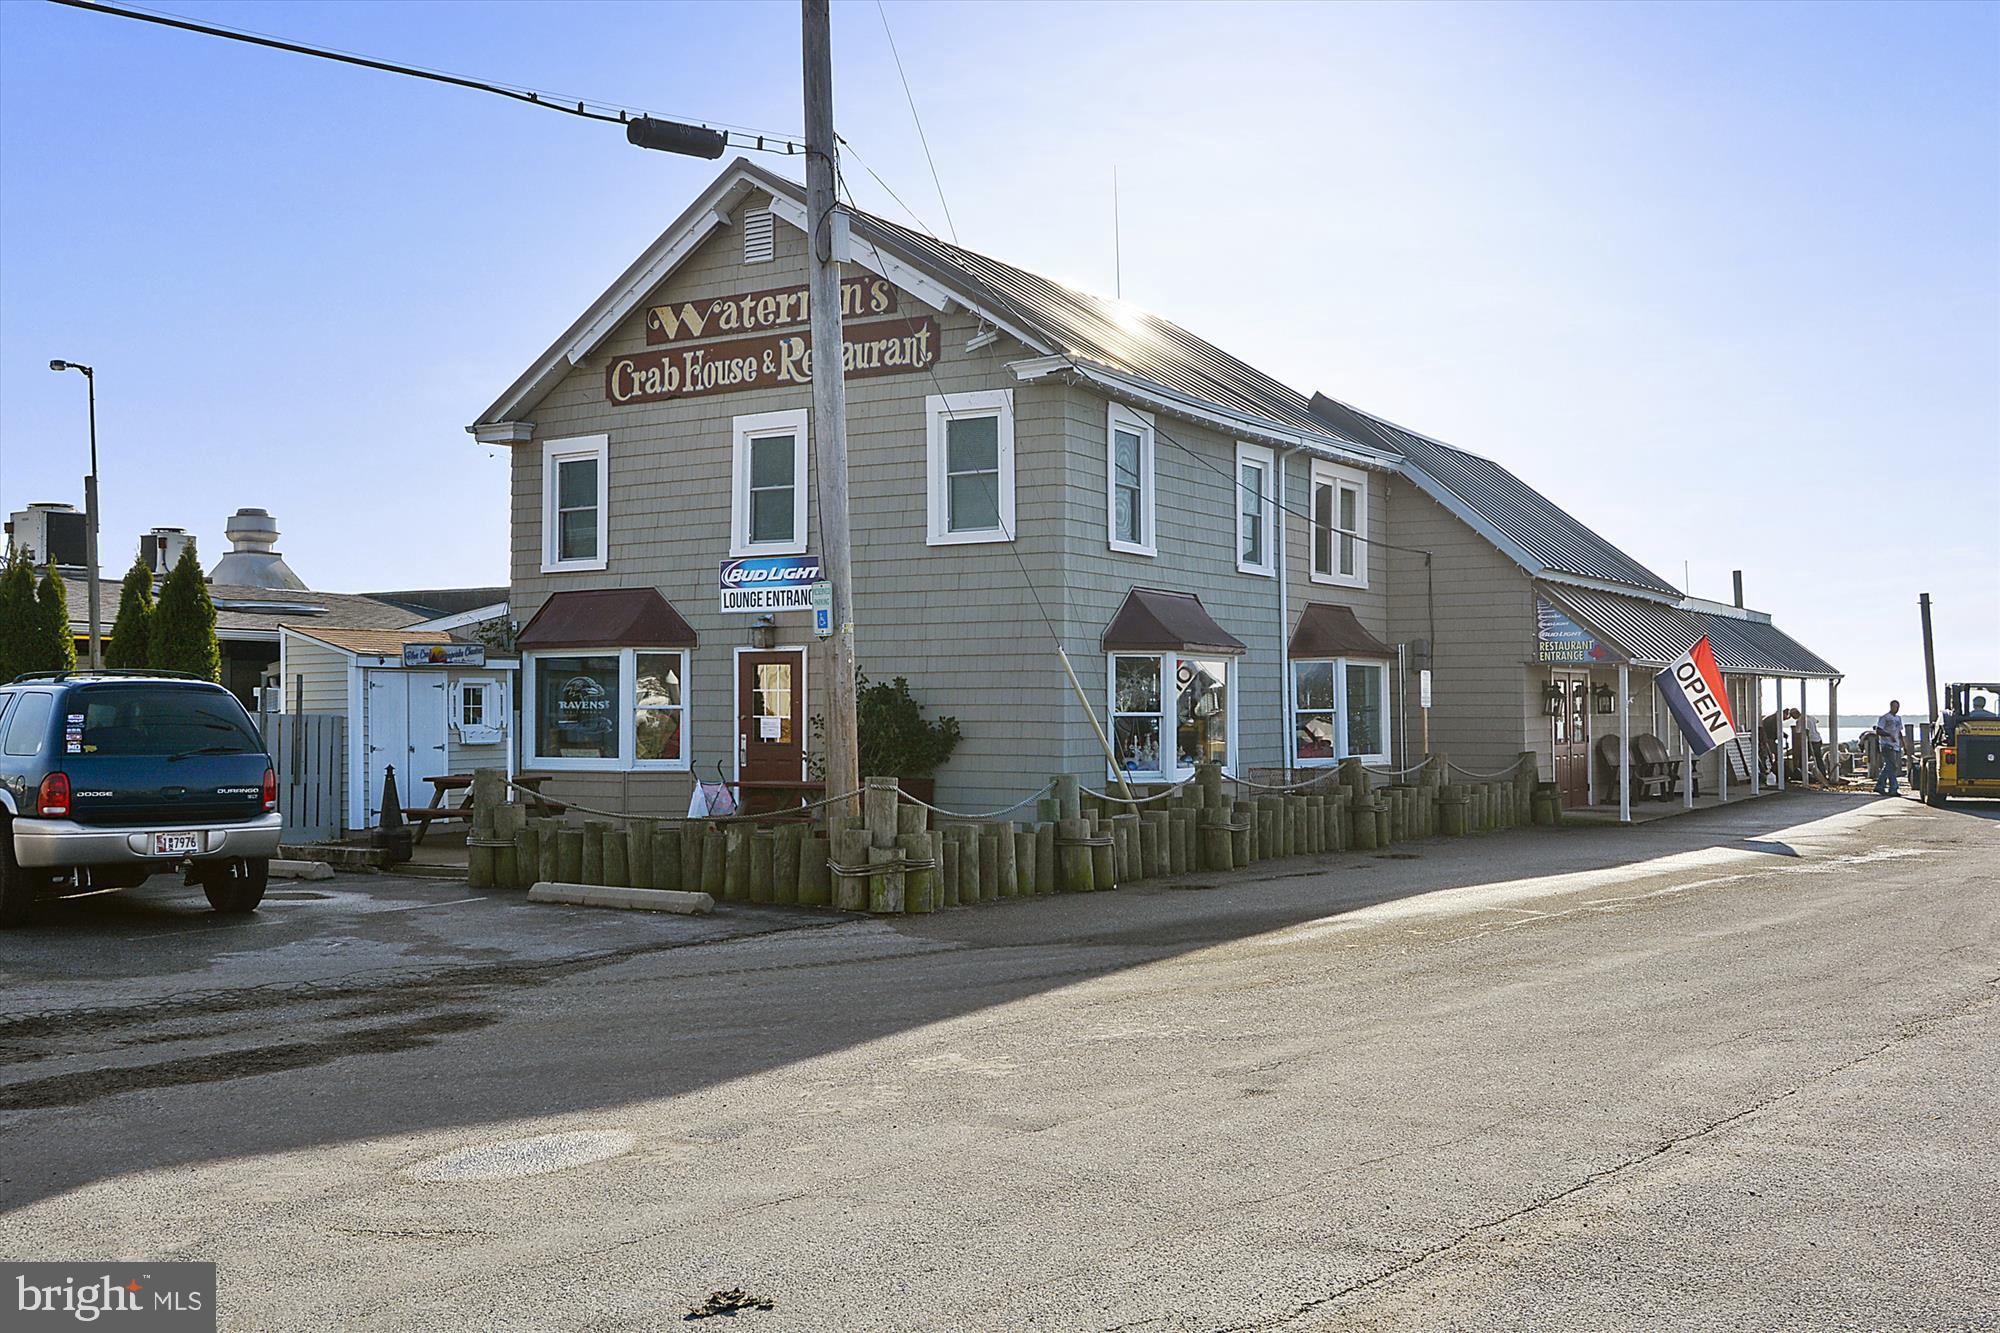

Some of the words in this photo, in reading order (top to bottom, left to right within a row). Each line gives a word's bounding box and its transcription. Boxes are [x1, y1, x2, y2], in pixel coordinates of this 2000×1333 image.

[648, 278, 889, 340] Watern's
[611, 357, 680, 401] Crab
[682, 350, 758, 392] House
[762, 349, 777, 375] &
[777, 322, 932, 383] Reaurant
[728, 568, 768, 582] BUD
[770, 566, 819, 581] LIGHT
[723, 591, 763, 609] LOUNGE
[1539, 639, 1595, 651] RESTAURANT
[1539, 651, 1585, 661] ENTRANCE
[558, 700, 606, 710] RAVENS
[1676, 662, 1728, 733] OPEN
